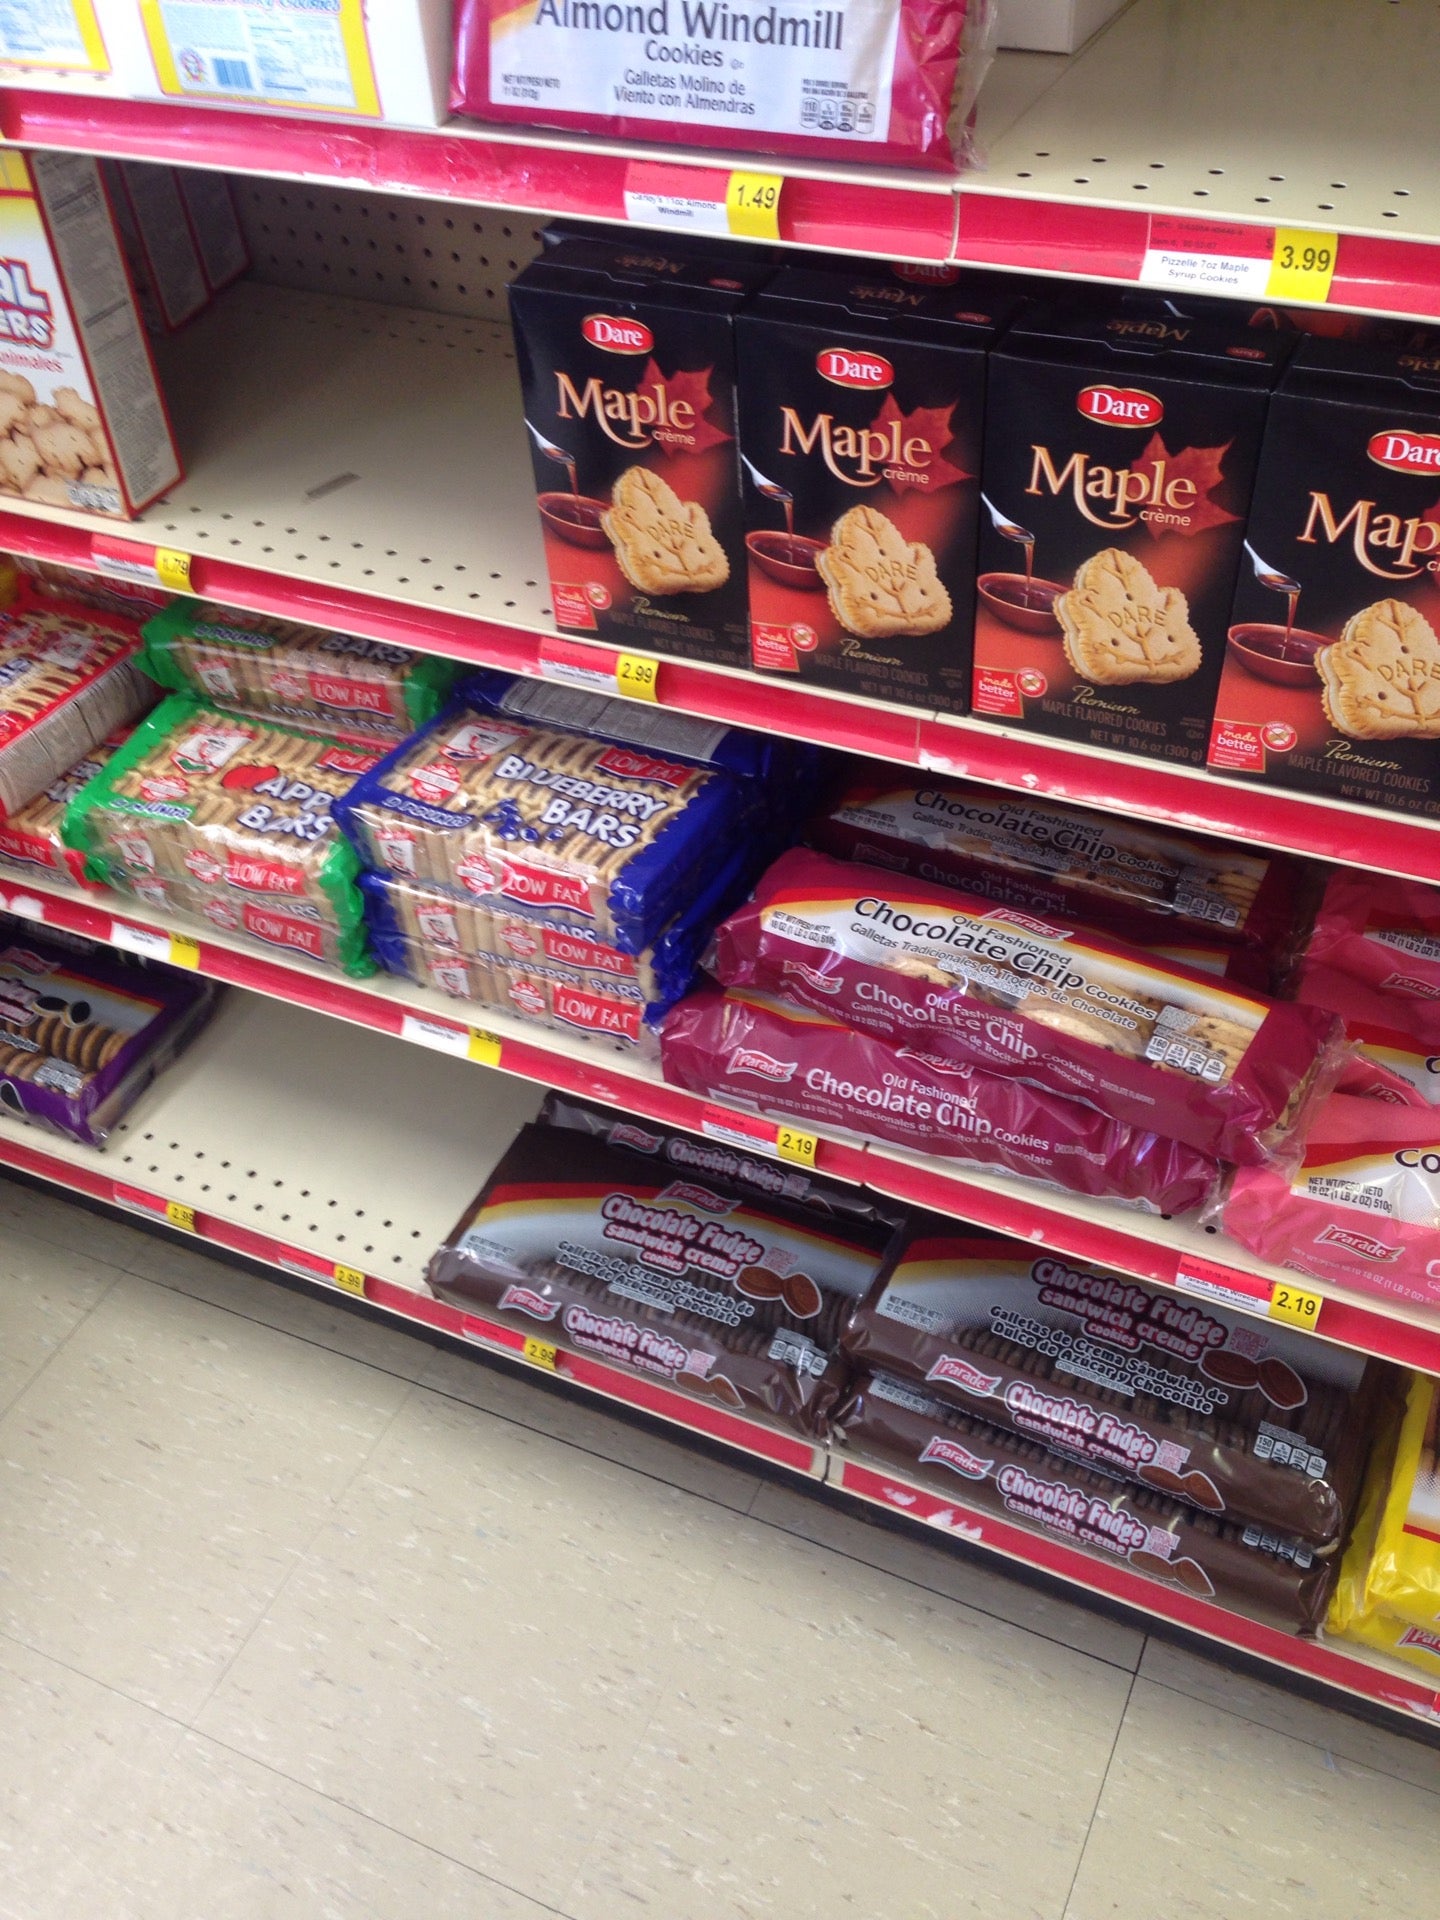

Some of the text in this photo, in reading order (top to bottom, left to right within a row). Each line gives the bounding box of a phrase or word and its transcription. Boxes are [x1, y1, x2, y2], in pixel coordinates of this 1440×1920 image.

[536, 0, 843, 49] Almond Windmill
[644, 39, 722, 67] Cookies
[624, 68, 745, 97] Galletas Molino de
[613, 86, 755, 117] Viento con Almendras
[737, 184, 776, 209] 1.49
[1161, 256, 1250, 273] Pizzelle 7oz Maple
[1280, 245, 1331, 273] 3.99
[1168, 269, 1239, 284] Syrup Cookies
[592, 319, 644, 346] Dare
[829, 353, 883, 381] Dare
[553, 370, 697, 449] Maple
[1089, 391, 1150, 420] Dare
[778, 405, 932, 487] Maple
[1025, 445, 1197, 530] Maple
[1139, 507, 1192, 527] crème
[1108, 604, 1168, 628] DARE
[320, 633, 413, 665] BARS
[622, 662, 653, 683] 2.99
[315, 681, 382, 708] LOW FAT
[978, 680, 1015, 699] better
[1075, 706, 1167, 737] FLAVORED COOKIES
[1223, 728, 1257, 743] made
[1217, 733, 1259, 753] better
[605, 753, 684, 780] LOW FAT
[1287, 753, 1431, 793] MAPLE FLAVORED COOKIES
[494, 753, 669, 821] BLUEBERRY
[1340, 784, 1422, 808] NET WT 10.6 oz
[236, 804, 336, 842] BARS
[539, 798, 643, 849] BARS
[911, 810, 955, 831] Galletas
[913, 787, 1050, 842] Chocolate
[1053, 829, 1118, 862] Chip
[998, 802, 1105, 838] Old Fashioned
[230, 860, 298, 891] LOW FAT
[506, 873, 582, 905] LOW FAT
[248, 913, 316, 948] LOW FAT
[952, 914, 1073, 965] Old Fashioned
[1000, 910, 1060, 938] Parade
[549, 938, 624, 971] LOW FAT
[853, 897, 1158, 1021] Chocolate Chip Cookies
[1414, 944, 1420, 953] 2
[850, 922, 1138, 1031] Galletas Tradicionales de Trocitos de Chocolate
[558, 994, 632, 1029] LOW FAT
[925, 993, 1024, 1034] Old Fashioned
[851, 1001, 1025, 1066] Galletas de Trocitos
[855, 981, 1095, 1083] Chocolate Chip Cookies
[737, 1054, 784, 1077] Parade
[882, 1072, 978, 1108] Old Fashioned
[801, 1090, 844, 1111] Galletas
[846, 1103, 915, 1129] Tradicionales
[918, 1121, 932, 1133] de
[805, 1067, 932, 1117] Chocolate
[936, 1103, 992, 1137] Chip
[993, 1127, 1050, 1152] Cookies
[782, 1133, 813, 1155] 2.19
[1308, 1176, 1383, 1198] NET NETO
[1308, 1185, 1393, 1214] 18 OZ (1 LB 2 OZ) 510g
[604, 1196, 762, 1262] Chocolate Fudge
[1331, 1231, 1388, 1257] Parade
[606, 1223, 738, 1276] sandwich creme
[642, 1251, 684, 1271] cookies
[338, 1270, 361, 1288] 2.99
[1373, 1275, 1384, 1285] OZ
[1393, 1282, 1404, 1294] LB
[1404, 1287, 1410, 1296] 2
[510, 1291, 550, 1314] Parade
[674, 1294, 741, 1326] Chocolate
[737, 1302, 754, 1316] de
[1034, 1261, 1146, 1313] Chocolate
[1150, 1298, 1227, 1346] Fudge
[1276, 1291, 1316, 1316] 2.19
[566, 1305, 689, 1369] Chocolate Fudge
[1040, 1287, 1200, 1360] sandwich creme
[1087, 1320, 1137, 1347] cookies
[529, 1343, 554, 1364] 2.99
[574, 1333, 675, 1379] sandwich creme
[989, 1306, 1229, 1405] Galletas de Crema Sándwich de
[991, 1322, 1214, 1415] Dulce de Azúcar y Chocolate
[940, 1361, 986, 1390] Parade
[1007, 1384, 1158, 1463] Chocolate Fudge
[1016, 1415, 1086, 1450] sandwich
[1088, 1440, 1136, 1470] creme
[933, 1445, 980, 1473] Parade
[1000, 1467, 1145, 1546] Chocolate Fudge
[1009, 1498, 1128, 1554] sandwich creme
